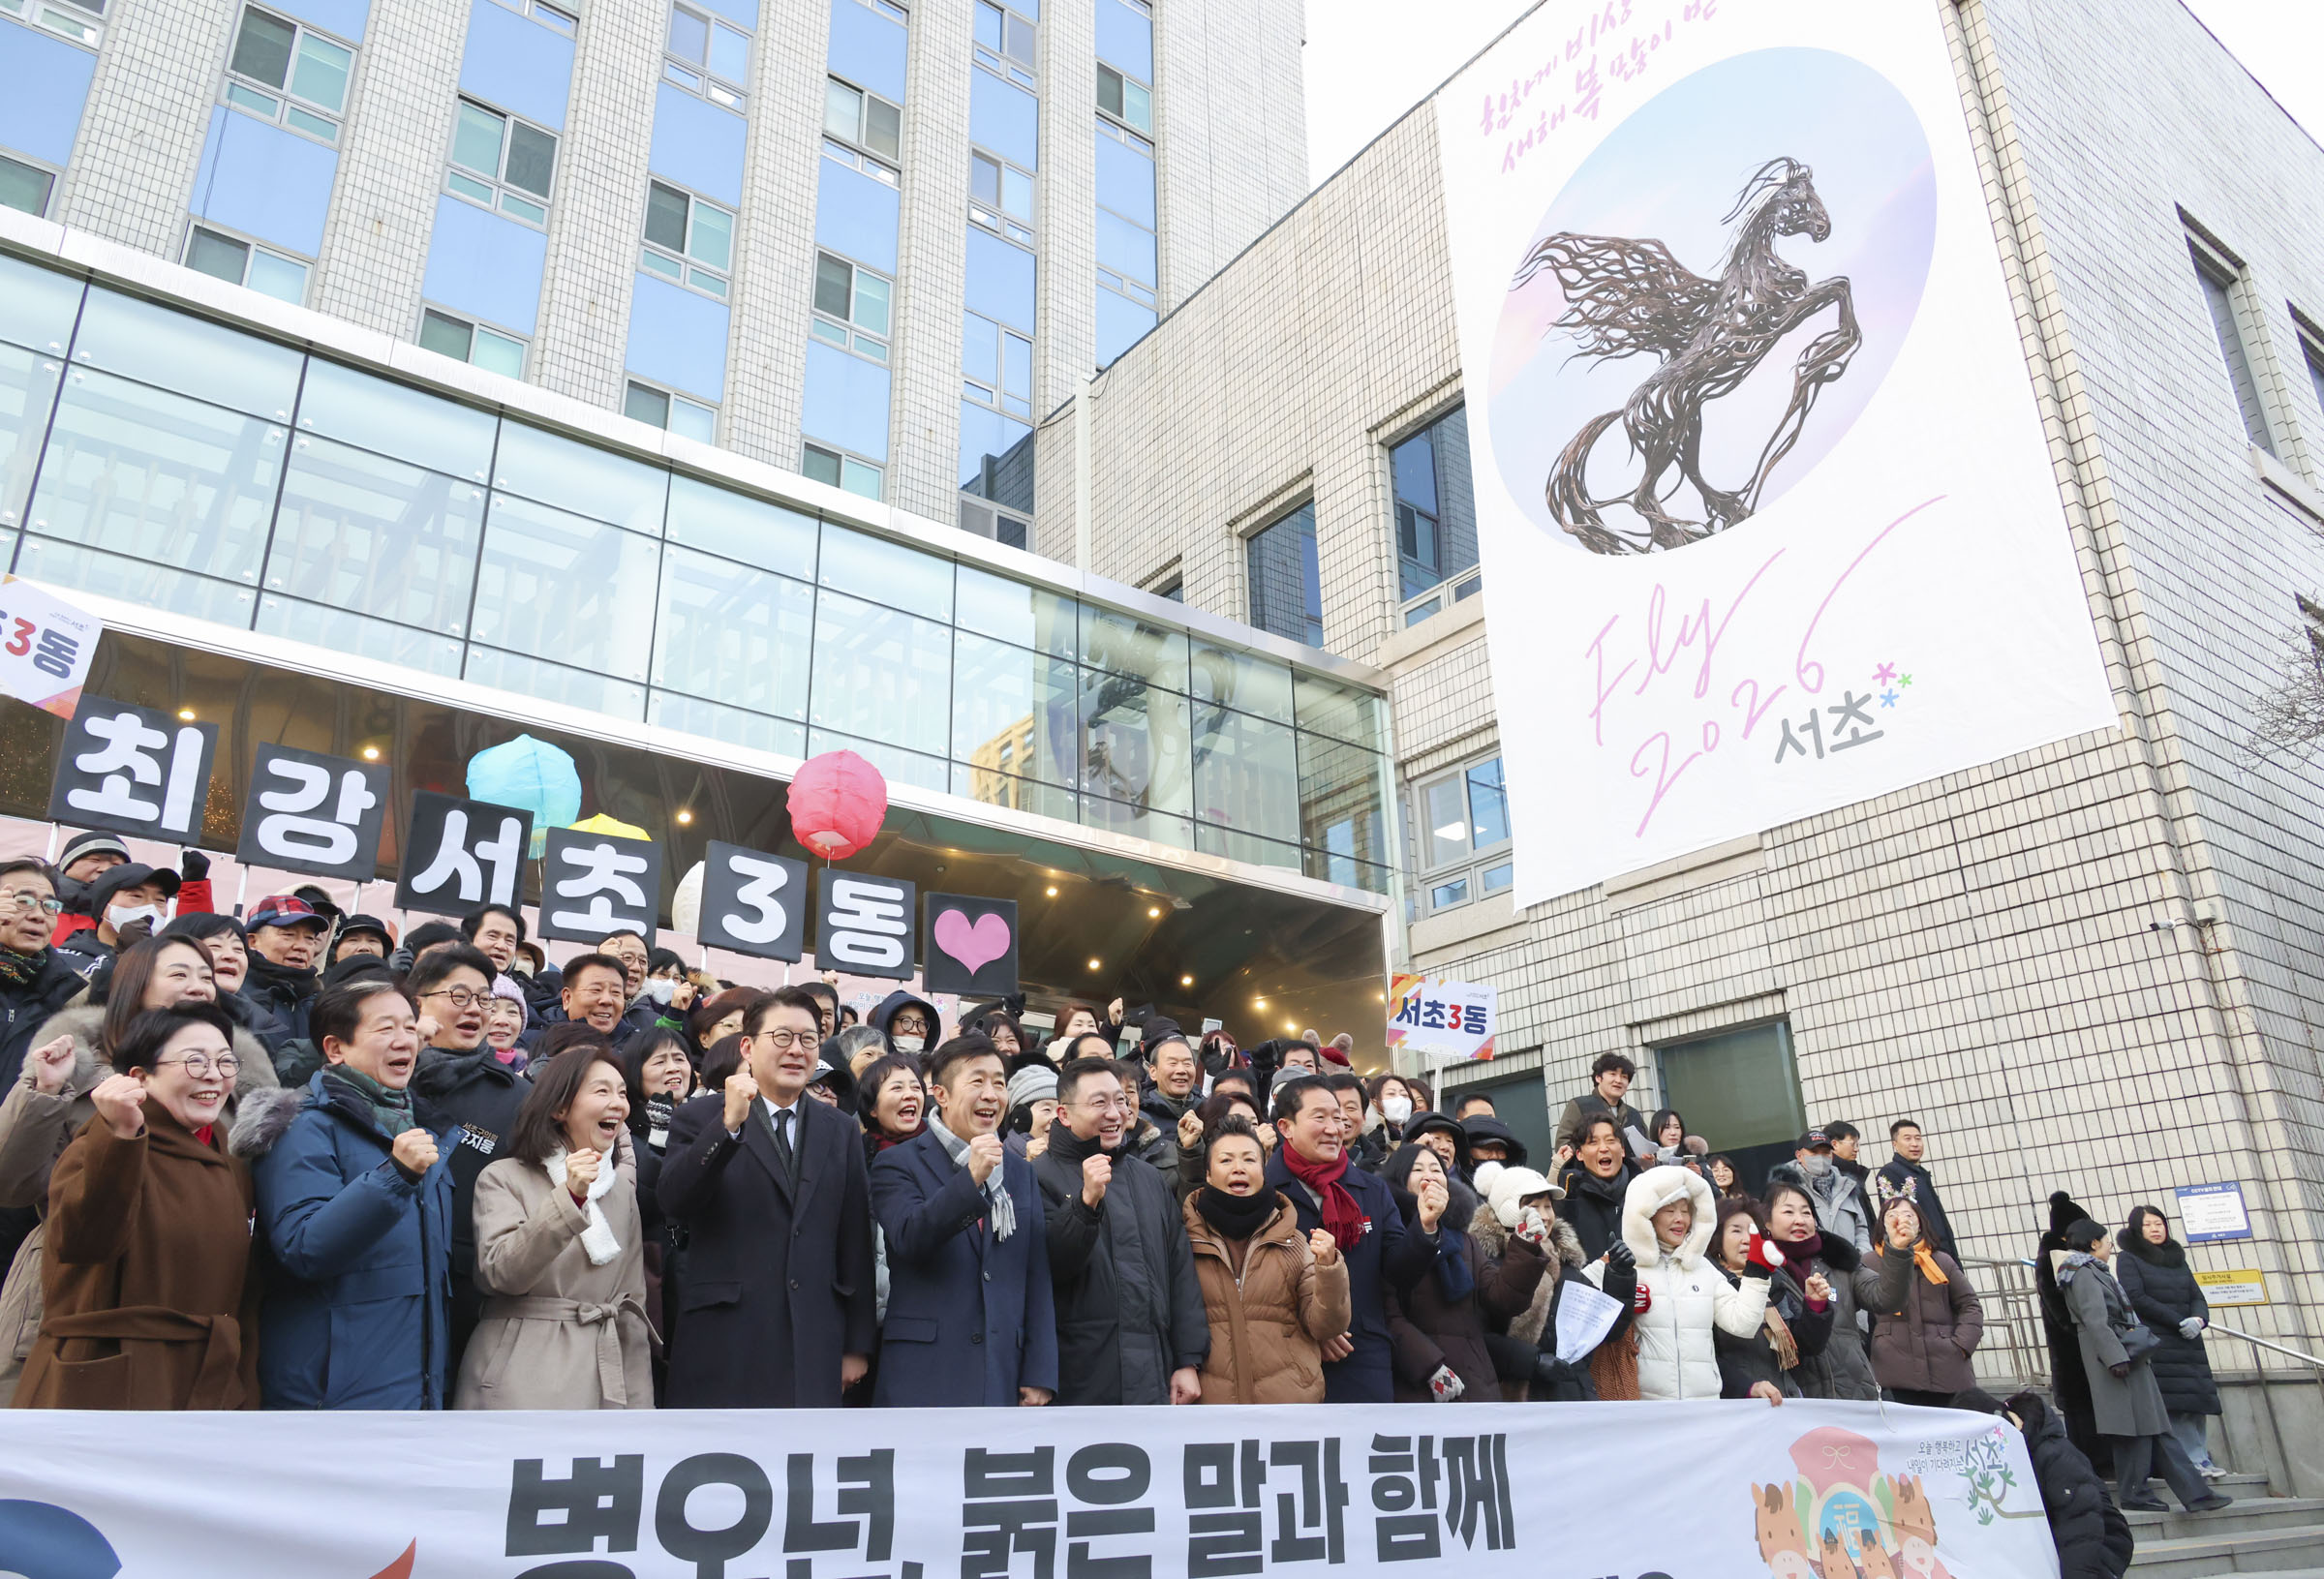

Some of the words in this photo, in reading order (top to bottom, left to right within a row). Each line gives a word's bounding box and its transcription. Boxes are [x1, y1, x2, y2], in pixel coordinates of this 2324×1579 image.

[1502, 104, 1565, 173] 새해
[1572, 53, 1604, 120] 복
[1608, 19, 1671, 82] 많이
[0, 609, 79, 680] 3동
[1586, 547, 1787, 747] Fly
[1630, 494, 1948, 838] 2026
[1774, 690, 1884, 765] 서초
[67, 712, 204, 834] 최
[258, 757, 377, 865] 강
[411, 809, 522, 905] 서
[550, 843, 648, 936] 초
[721, 855, 788, 944] 3
[827, 879, 907, 967] 동
[1395, 996, 1487, 1035] 서초3동
[1907, 1458, 1929, 1474] 내일이
[1929, 1455, 1966, 1473] 기다려지는
[1917, 1442, 1933, 1455] 오늘
[1935, 1440, 1962, 1455] 행복하고
[1965, 1435, 2003, 1472] 서초
[961, 1442, 1155, 1579] 붉은
[1183, 1438, 1350, 1579] 말과
[1367, 1433, 1516, 1563] 함께
